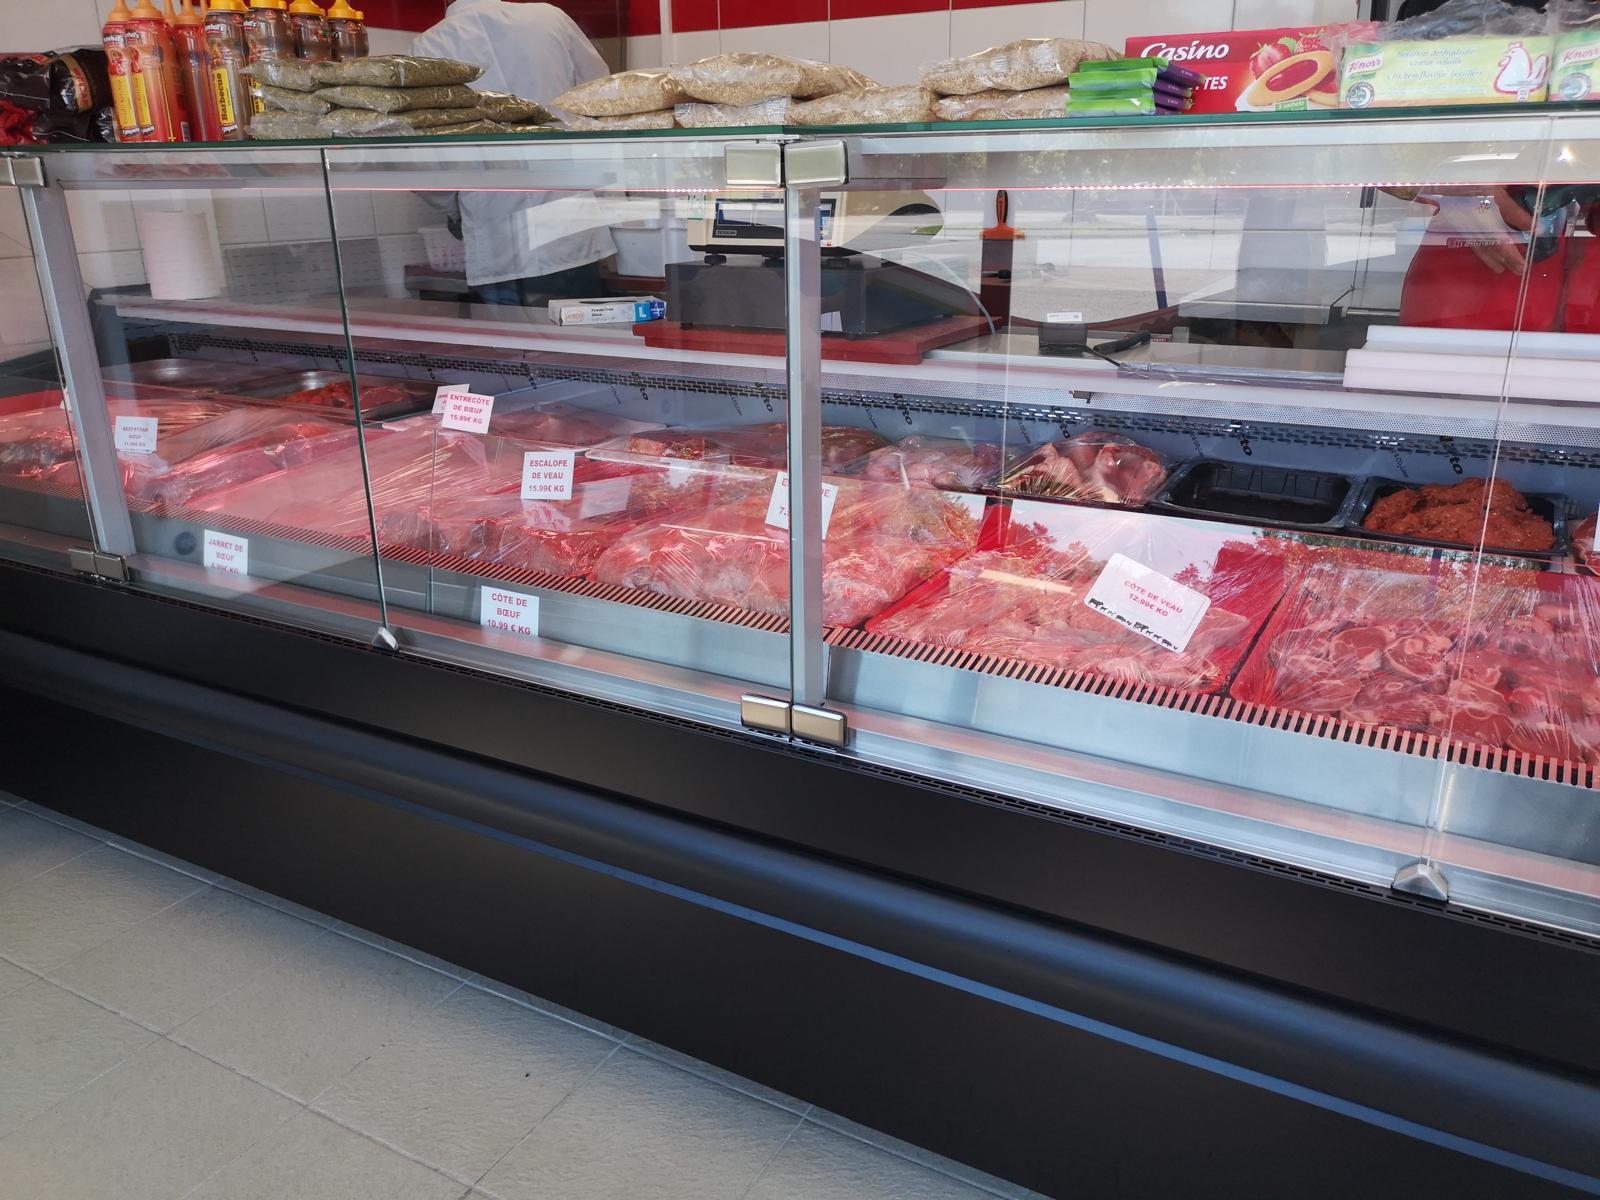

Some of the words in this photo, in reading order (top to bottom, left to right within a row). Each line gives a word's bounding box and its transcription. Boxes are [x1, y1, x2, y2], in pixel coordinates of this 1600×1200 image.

[1141, 40, 1229, 61] Casino
[1349, 58, 1381, 72] Knorr
[215, 73, 228, 121] Barbecue
[639, 306, 646, 317] L
[450, 394, 490, 405] ENTRECÔTE
[530, 459, 568, 467] ESCALOPE
[208, 539, 232, 550] JARRET
[234, 544, 243, 552] DE
[491, 592, 514, 605] CÔTE
[516, 598, 528, 607] DE
[1124, 580, 1146, 595] CÔTE
[1147, 592, 1159, 601] DE
[1161, 598, 1183, 613] VEAU
[1155, 607, 1169, 617] KG
[488, 619, 509, 631] 10.99
[518, 626, 531, 635] KG
